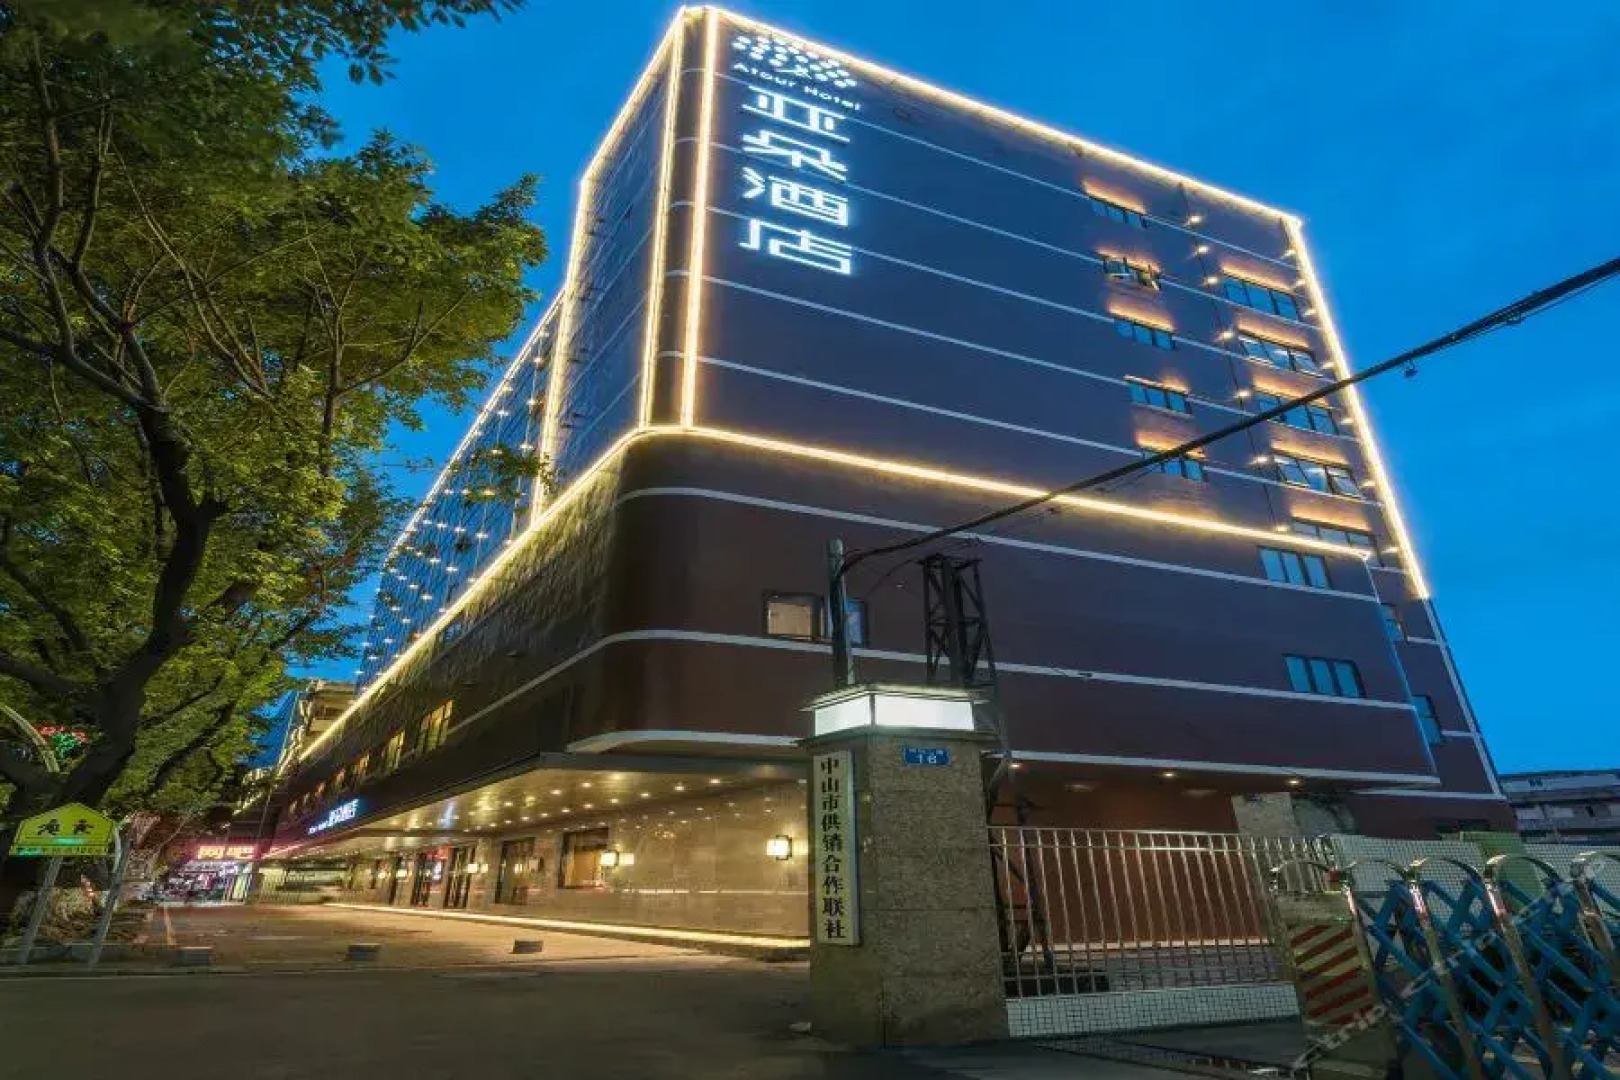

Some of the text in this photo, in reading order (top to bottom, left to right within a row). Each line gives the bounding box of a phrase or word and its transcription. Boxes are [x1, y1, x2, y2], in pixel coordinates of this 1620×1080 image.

[739, 85, 851, 275] 亚朵酒店
[820, 756, 846, 939] 中山市供销合作联社
